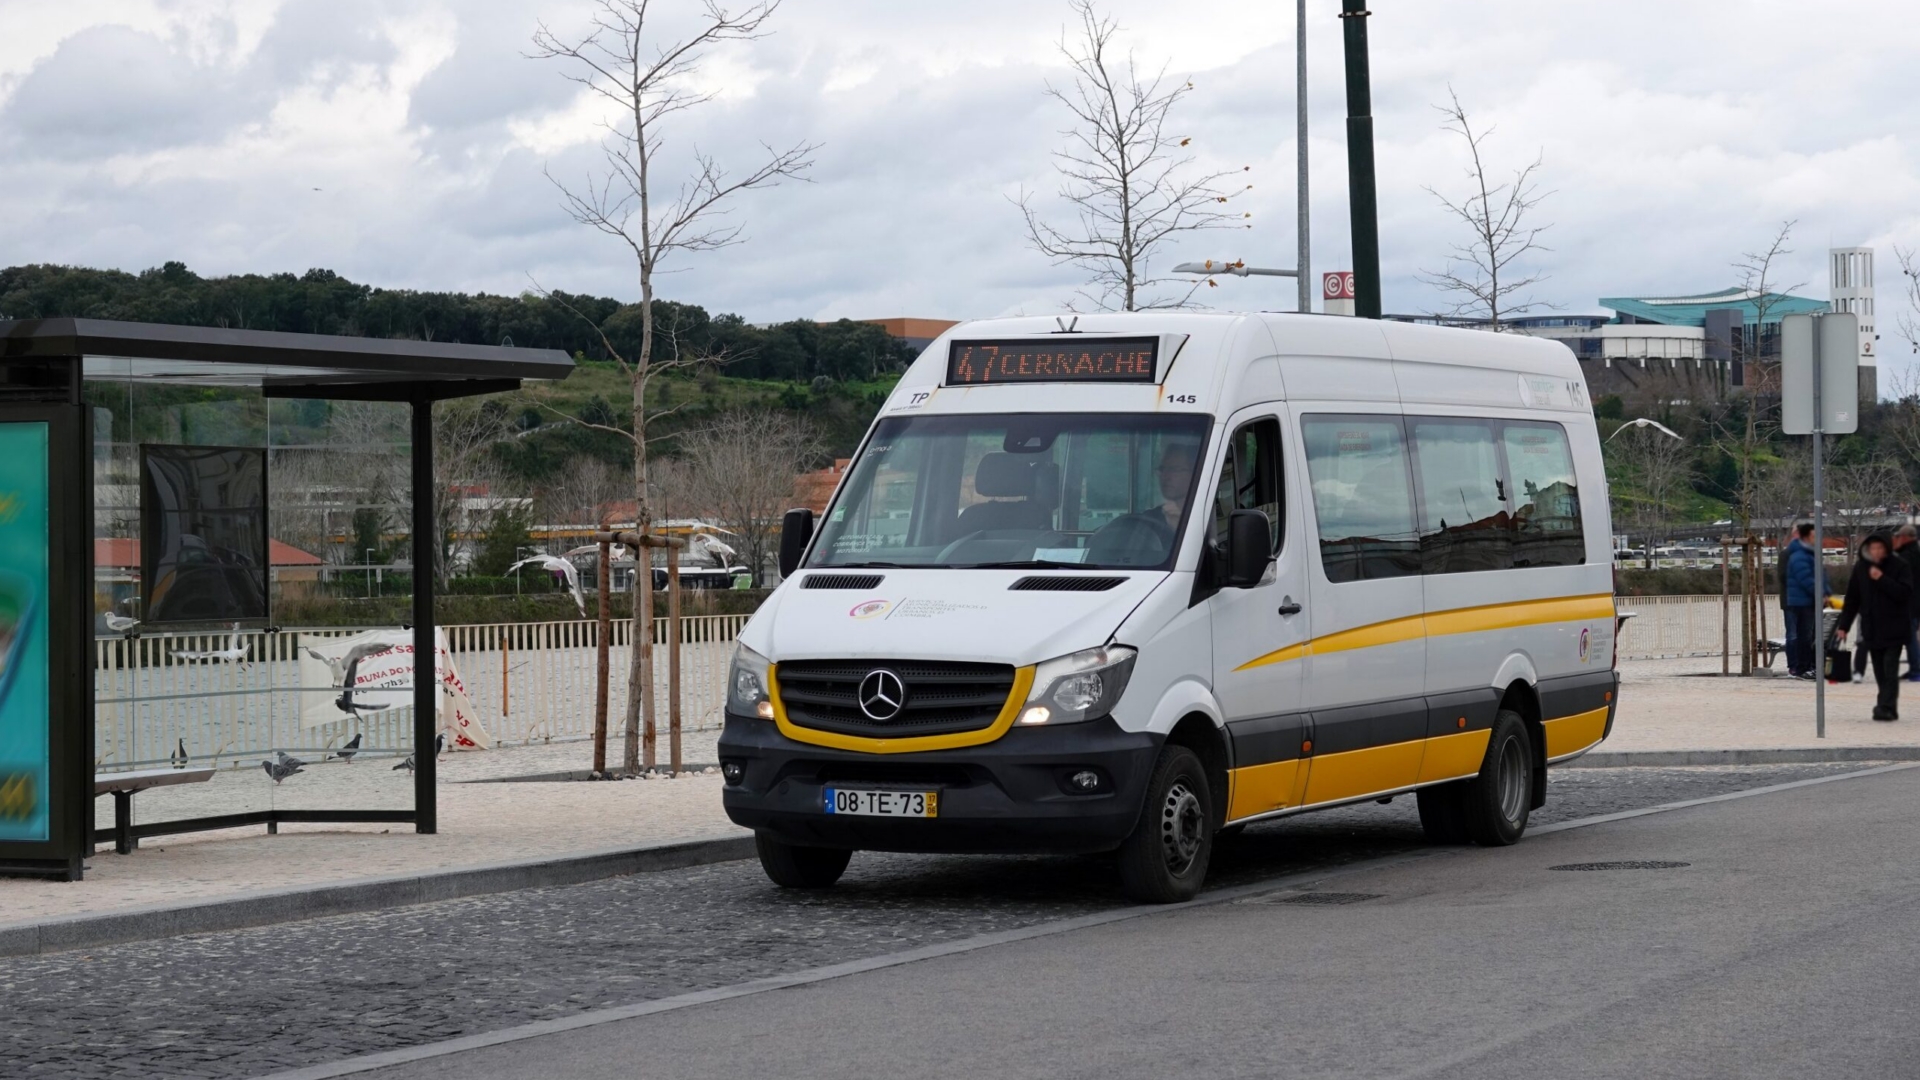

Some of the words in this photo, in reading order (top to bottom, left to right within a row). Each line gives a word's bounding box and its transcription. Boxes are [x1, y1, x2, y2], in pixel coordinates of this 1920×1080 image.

[957, 346, 999, 382] 47
[1000, 351, 1152, 376] CERNACHE
[910, 392, 930, 404] TP
[1166, 394, 1197, 404] 145
[1566, 381, 1584, 407] 145
